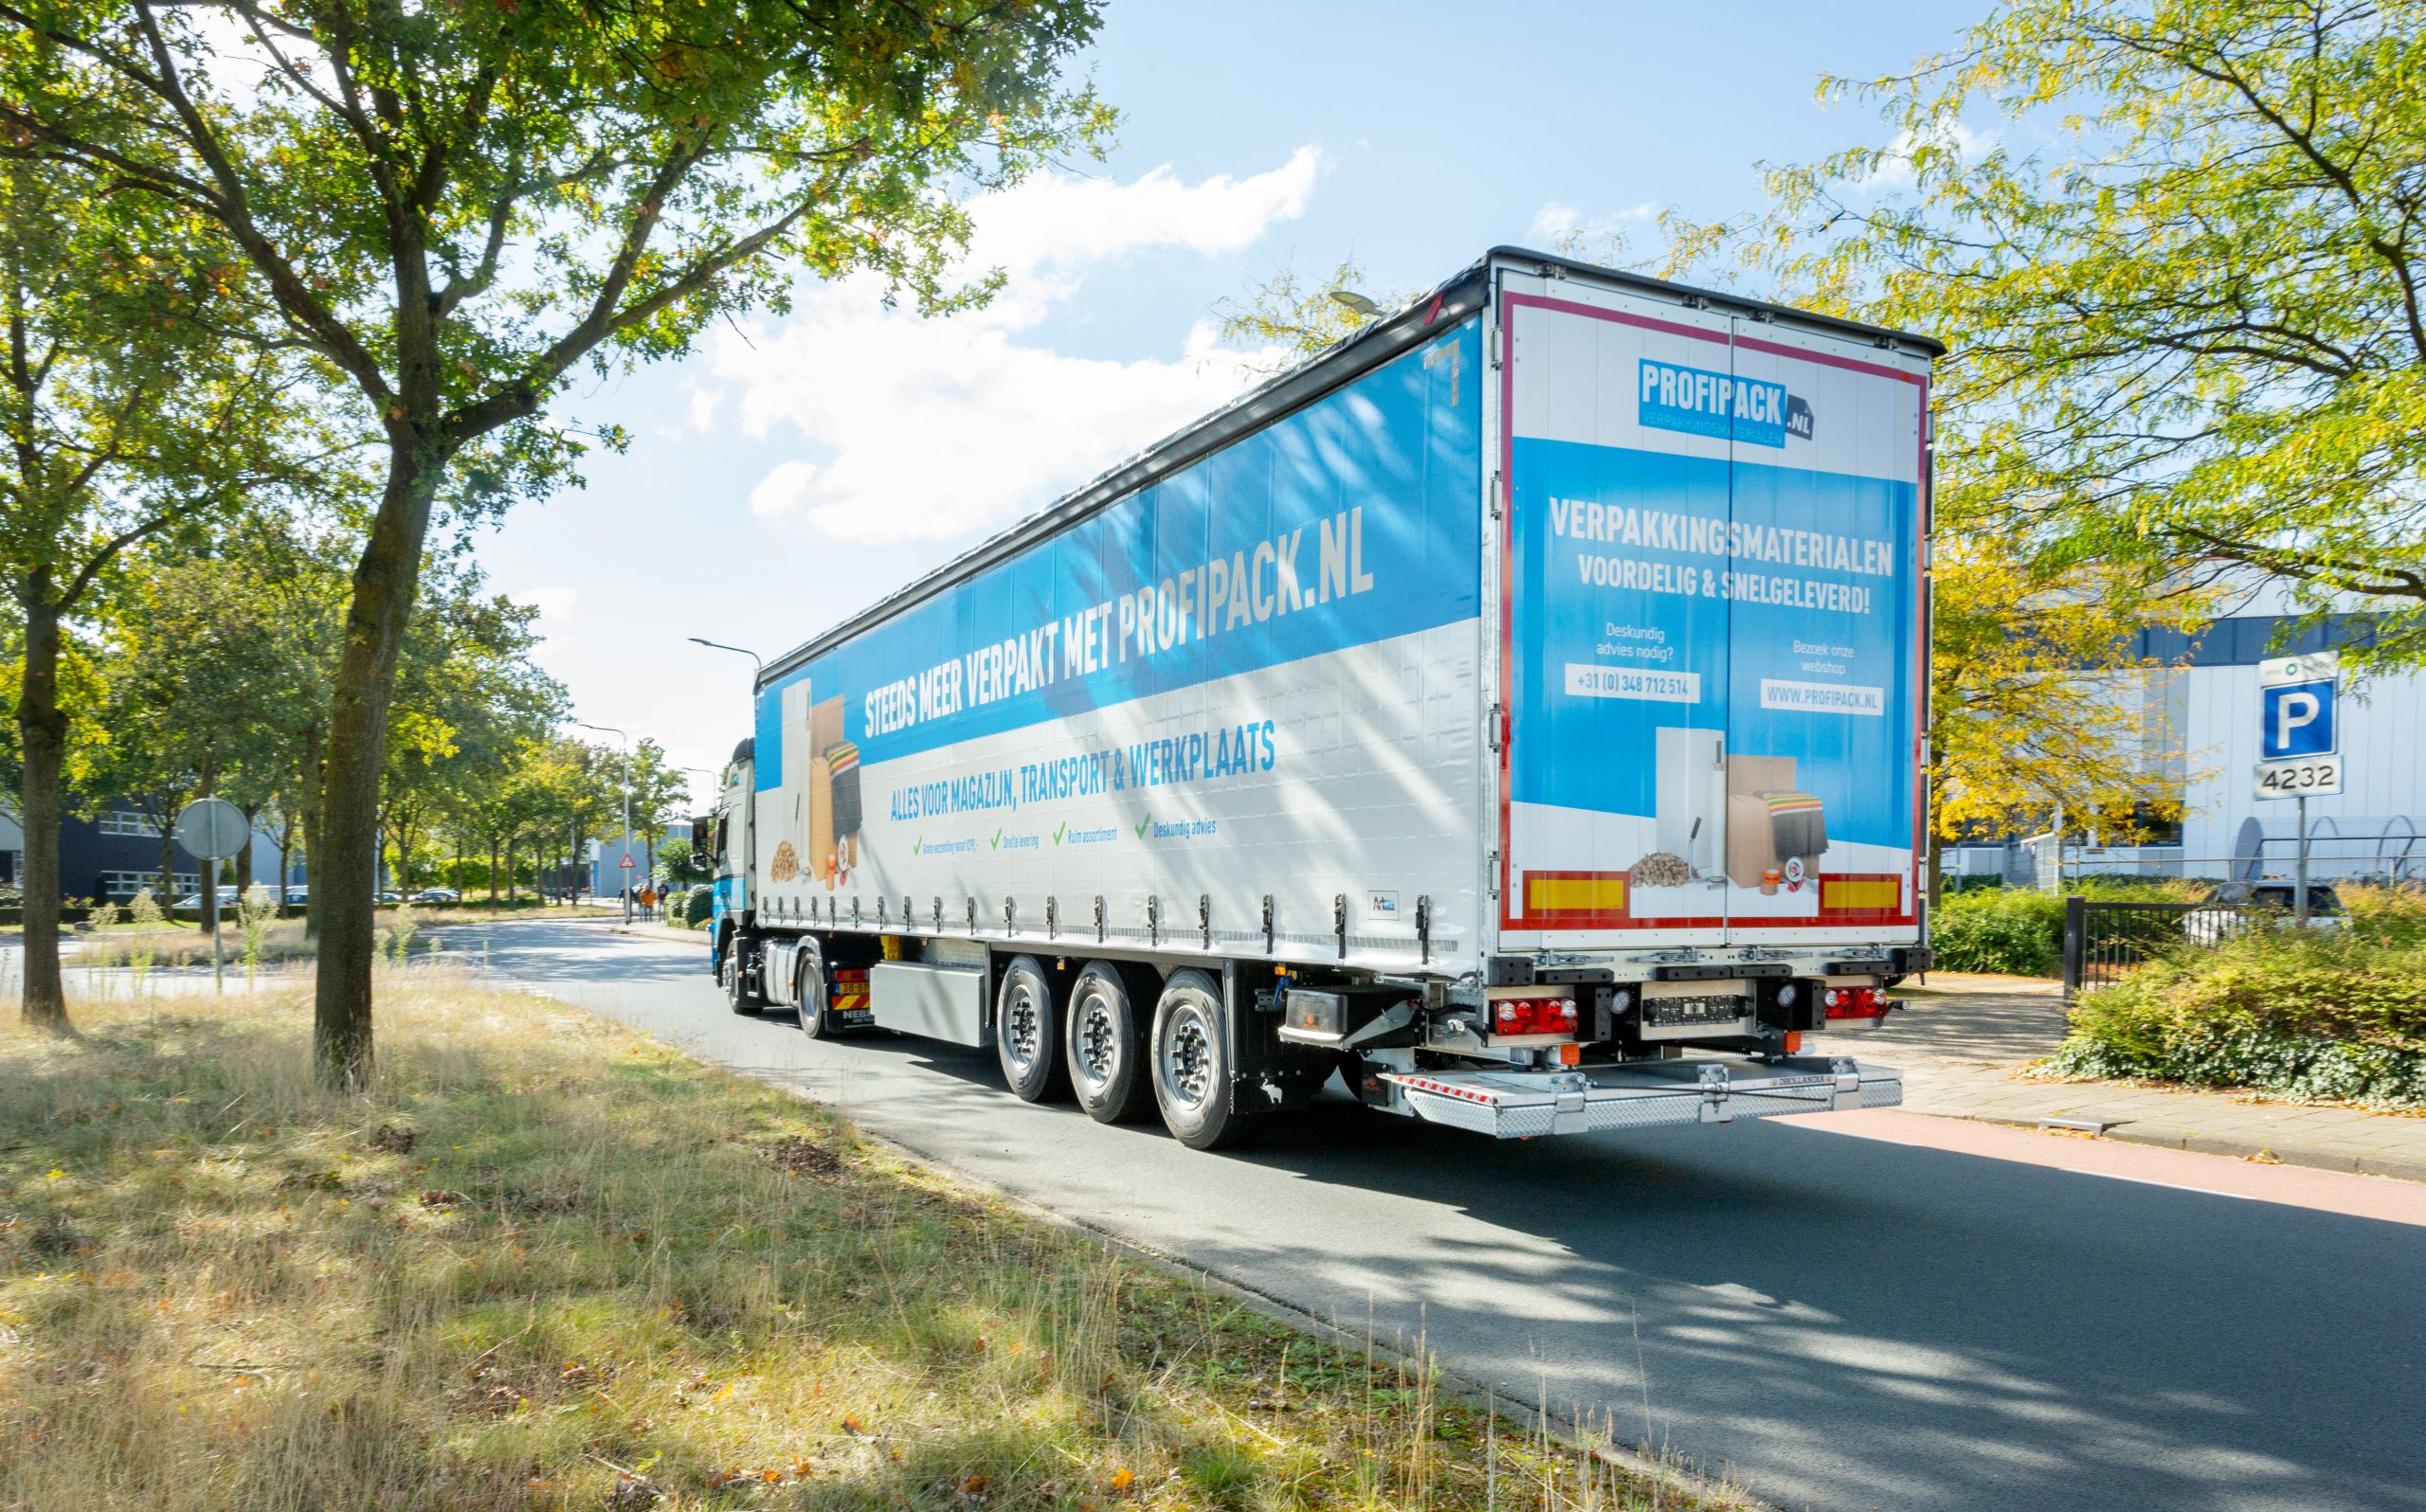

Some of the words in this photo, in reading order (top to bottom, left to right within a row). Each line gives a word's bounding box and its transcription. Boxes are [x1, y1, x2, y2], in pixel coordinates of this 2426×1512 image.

[1642, 364, 1782, 425] PROFIPACK
[1786, 413, 1810, 435] .NL
[1643, 410, 1783, 444] VERPAKKINGSMATERIALEN
[1549, 497, 1892, 577] VERPAKKINGSMATERIALEN
[1578, 554, 1697, 597] VOORDELIG
[1702, 568, 1716, 599] &
[1721, 570, 1870, 614] SNELGELEVERD!
[865, 675, 916, 738] STEEDS
[919, 658, 962, 723] MEER
[967, 621, 1059, 708] VERPAKT
[1064, 601, 1113, 679] MET
[1119, 506, 1373, 663] PROFIPACK.NL
[1606, 622, 1665, 643] Deskundig
[1597, 642, 1634, 657] advies
[1637, 646, 1674, 662] nodig?
[1794, 640, 1829, 656] Bezoek
[1831, 646, 1855, 657] onze
[1802, 661, 1846, 675] webshop
[1578, 673, 1599, 689] +31
[1603, 674, 1619, 692] (0)
[1622, 675, 1642, 692] 348
[1646, 677, 1666, 694] 712
[1669, 679, 1689, 694] 514
[1766, 686, 1877, 709] WWW.PROFIPACK.NL
[2277, 692, 2320, 749] P
[891, 786, 919, 821] ALLES
[921, 781, 948, 817] VOOR
[951, 766, 1017, 812] MAGAZIJN,
[1021, 750, 1110, 804] TRANSPORT
[1114, 747, 1125, 790] &
[1130, 719, 1275, 789] WERKPLAATS
[2262, 765, 2335, 791] 4232
[1068, 829, 1081, 844] Ruim
[1082, 826, 1118, 843] assortiment
[1154, 819, 1190, 839] Deskundig
[1192, 817, 1217, 835] advies
[1003, 835, 1019, 850] Snelle
[1020, 833, 1039, 850] levering
